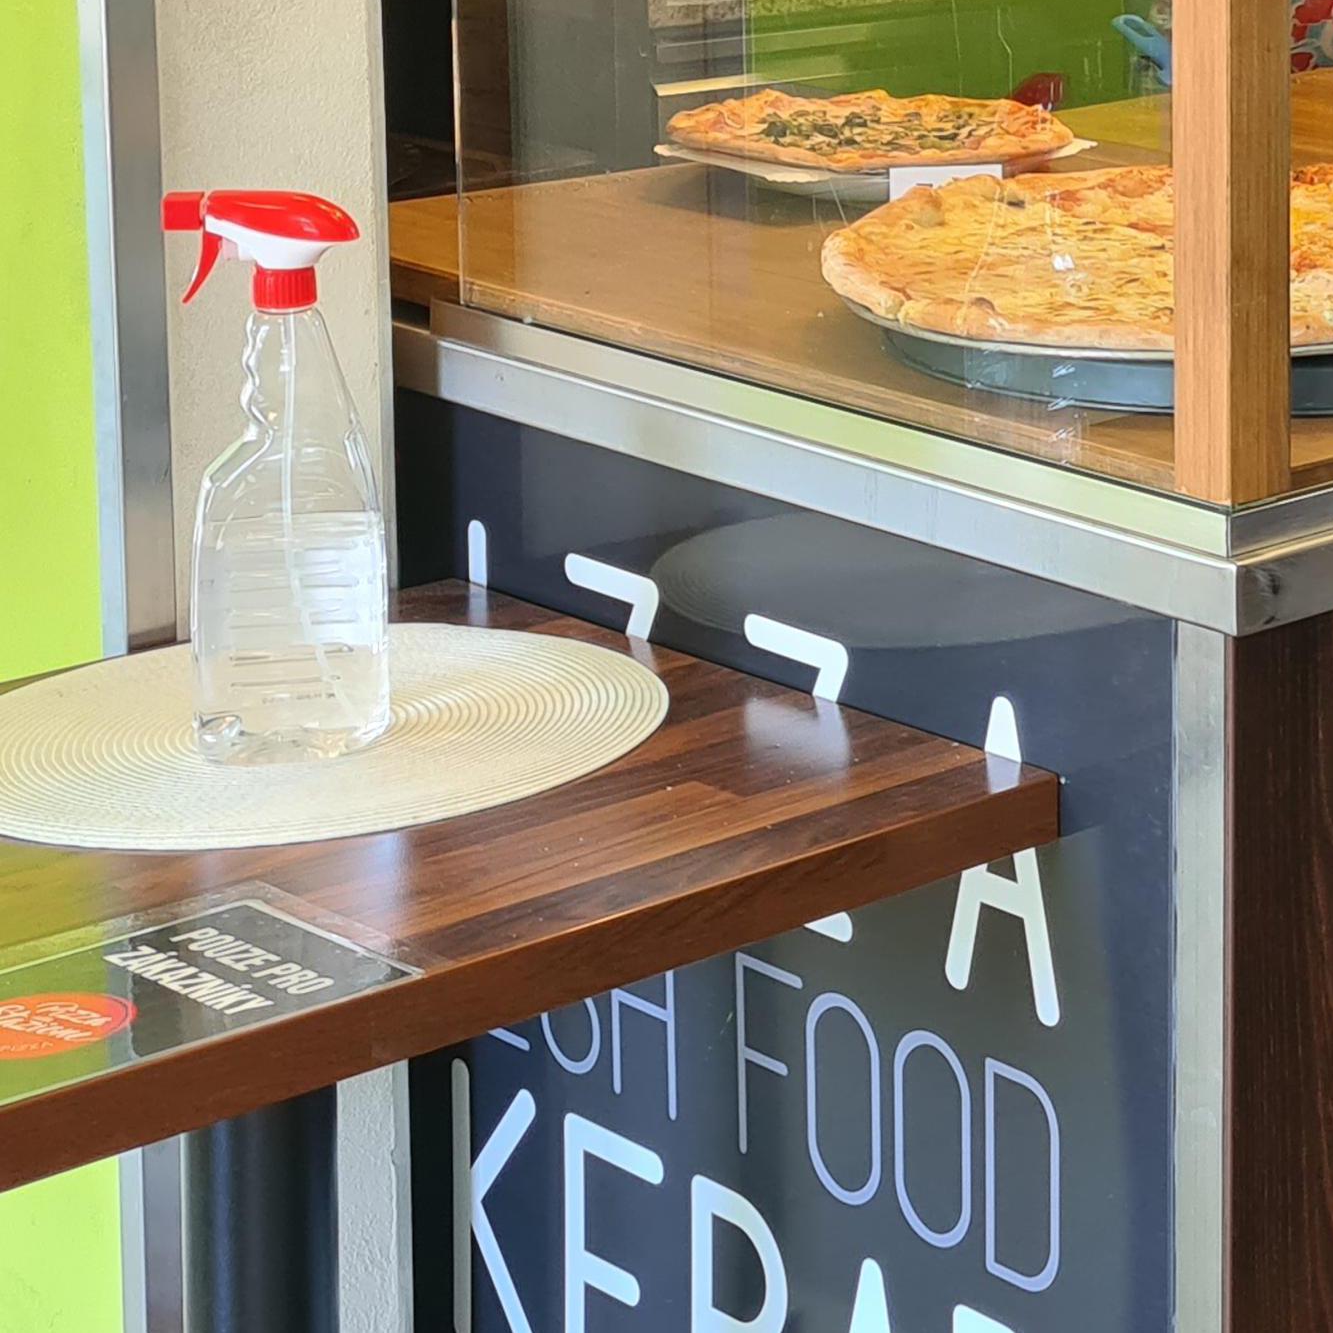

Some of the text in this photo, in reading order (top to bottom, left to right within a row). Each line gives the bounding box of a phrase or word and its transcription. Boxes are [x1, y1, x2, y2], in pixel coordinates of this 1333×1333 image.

[102, 944, 276, 1016] ZÁKAZNÍKY
[169, 926, 335, 996] POUZE PRO
[734, 952, 1062, 1294] FOOD
